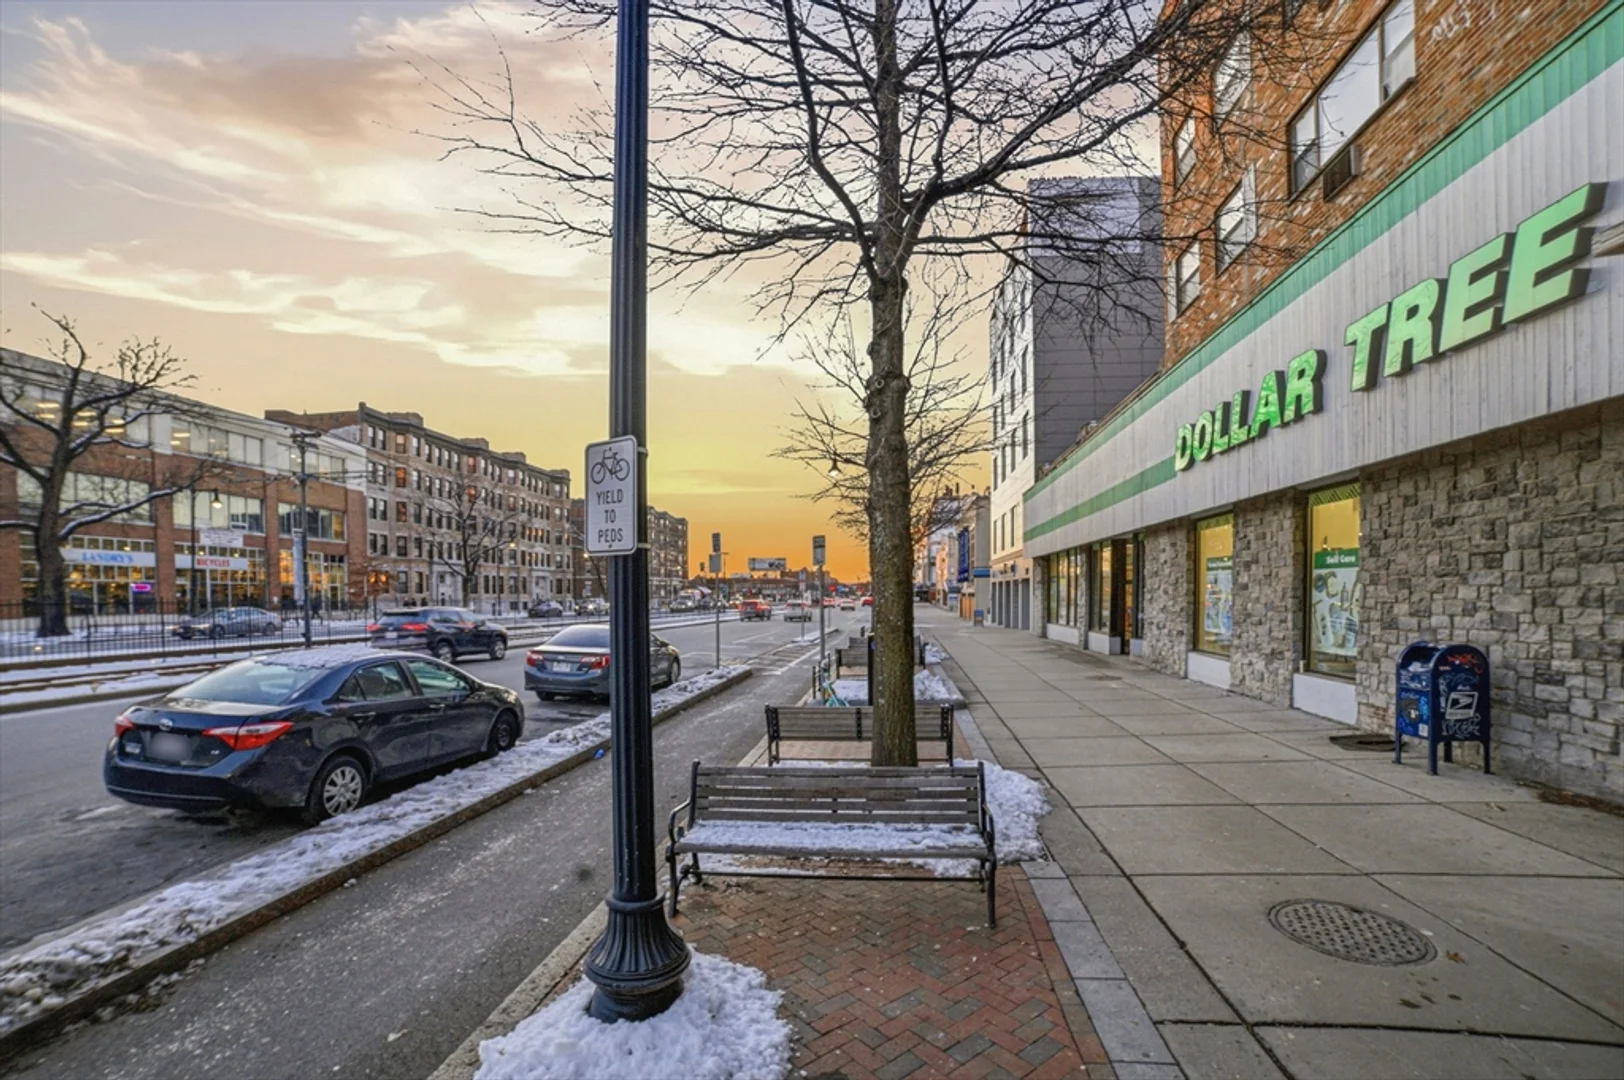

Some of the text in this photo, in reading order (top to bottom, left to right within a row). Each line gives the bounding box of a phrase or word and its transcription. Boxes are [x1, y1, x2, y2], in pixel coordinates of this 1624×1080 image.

[1174, 182, 1603, 472] DOLLAR TREE
[596, 489, 624, 506] YIELD
[604, 509, 616, 524] TO
[598, 528, 624, 543] PEDS
[197, 558, 230, 567] BICYCLES
